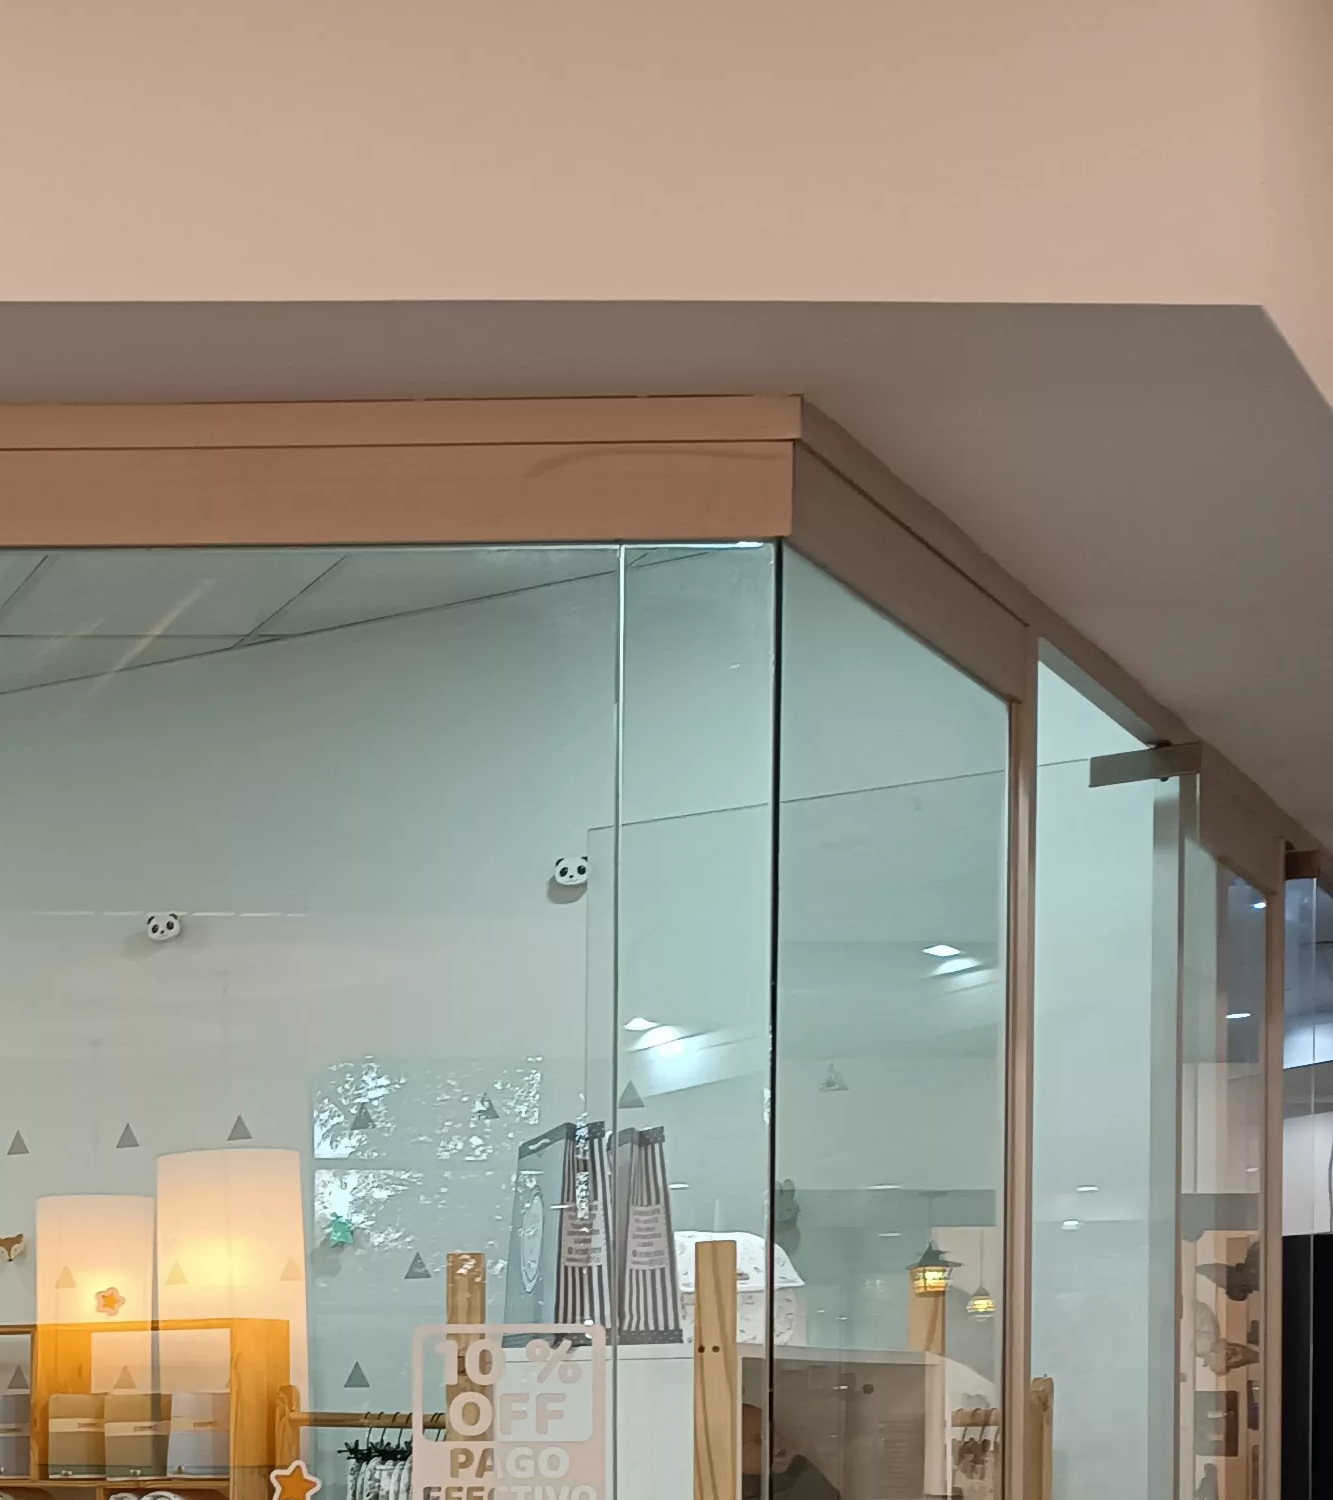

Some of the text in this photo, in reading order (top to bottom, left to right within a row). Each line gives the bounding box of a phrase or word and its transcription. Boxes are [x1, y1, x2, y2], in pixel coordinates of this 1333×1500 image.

[436, 1339, 505, 1386] 10
[449, 1391, 567, 1436] OFF
[450, 1447, 569, 1479] PAGO
